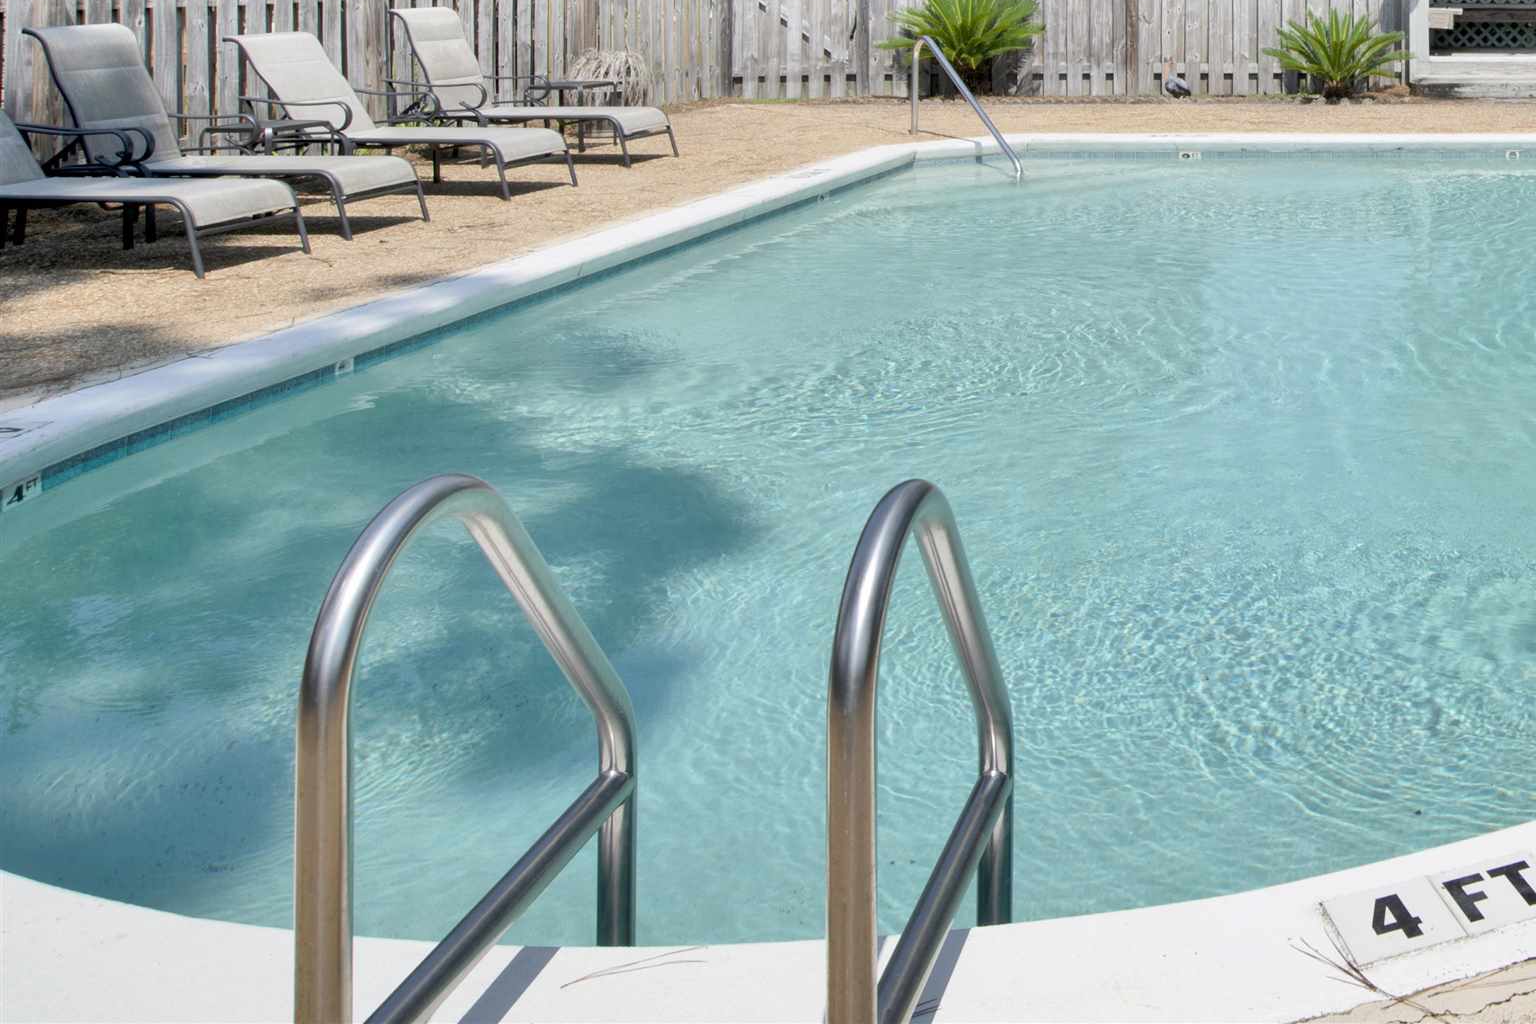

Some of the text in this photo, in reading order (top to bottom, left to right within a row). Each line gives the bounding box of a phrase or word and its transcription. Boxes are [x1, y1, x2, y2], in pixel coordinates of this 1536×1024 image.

[6, 477, 39, 506] 4 FT
[1372, 894, 1424, 938] 4
